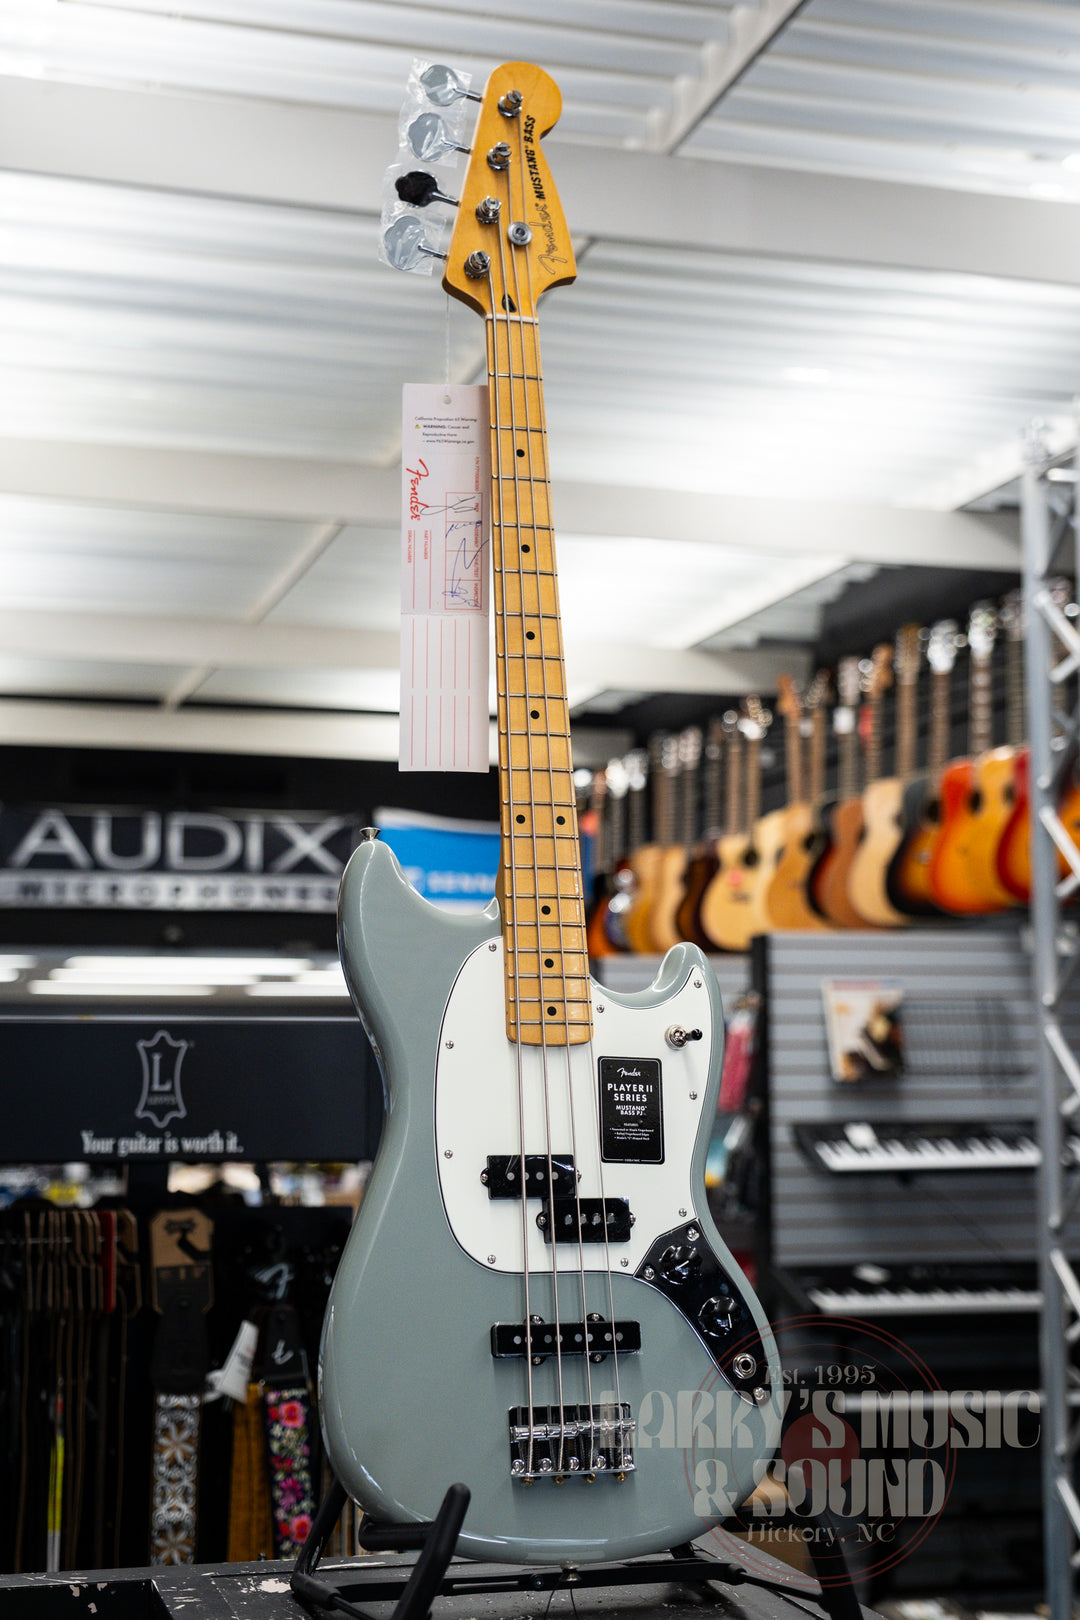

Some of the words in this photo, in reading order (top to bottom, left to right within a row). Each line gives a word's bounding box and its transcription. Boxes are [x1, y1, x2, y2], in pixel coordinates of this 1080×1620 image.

[523, 114, 537, 144] BASS
[525, 148, 546, 201] MUSTANG
[406, 458, 429, 521] Fender
[9, 809, 347, 873] AUDIX
[616, 1067, 641, 1077] Fender
[607, 1083, 644, 1092] PLAYER
[646, 1084, 653, 1093] II
[613, 1093, 647, 1102] SERIES
[80, 1130, 115, 1153] Your
[118, 1131, 162, 1157] guitar
[164, 1132, 178, 1153] is
[181, 1130, 224, 1153] worth
[226, 1131, 244, 1153] it.
